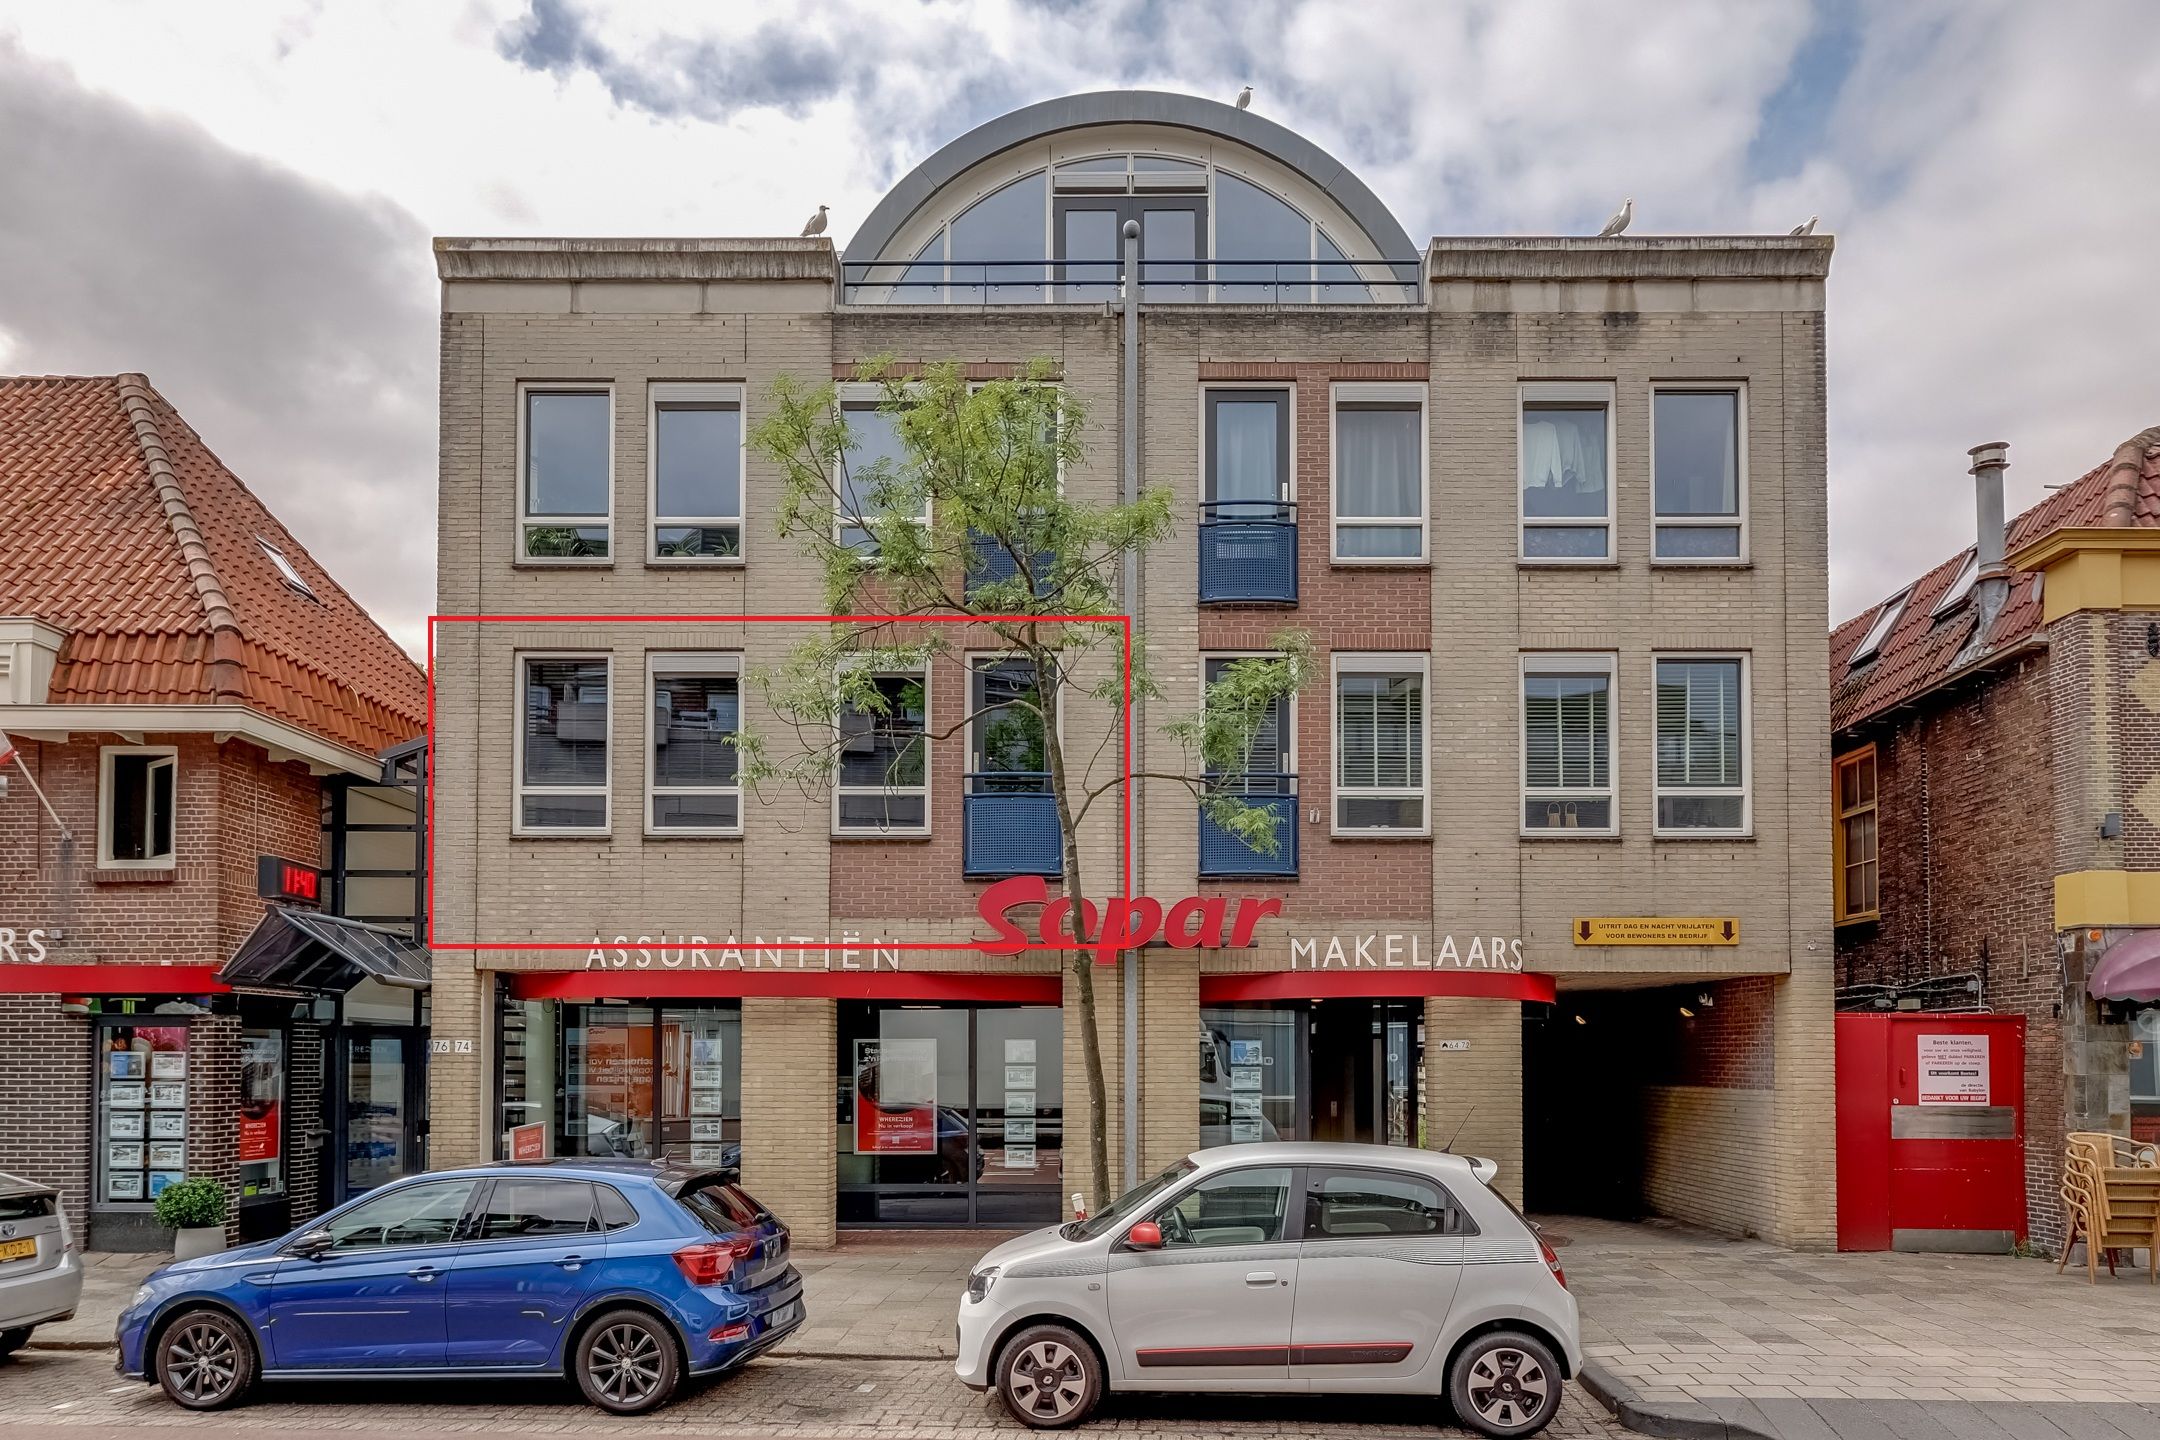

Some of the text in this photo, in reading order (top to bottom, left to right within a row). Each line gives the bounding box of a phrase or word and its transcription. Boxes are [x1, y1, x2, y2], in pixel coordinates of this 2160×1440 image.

[970, 875, 1283, 966] Sopar
[585, 931, 899, 968] ASSURANTIËN
[1291, 934, 1523, 971] MAKELAARS
[434, 1041, 448, 1052] 76
[456, 1041, 470, 1052] 74
